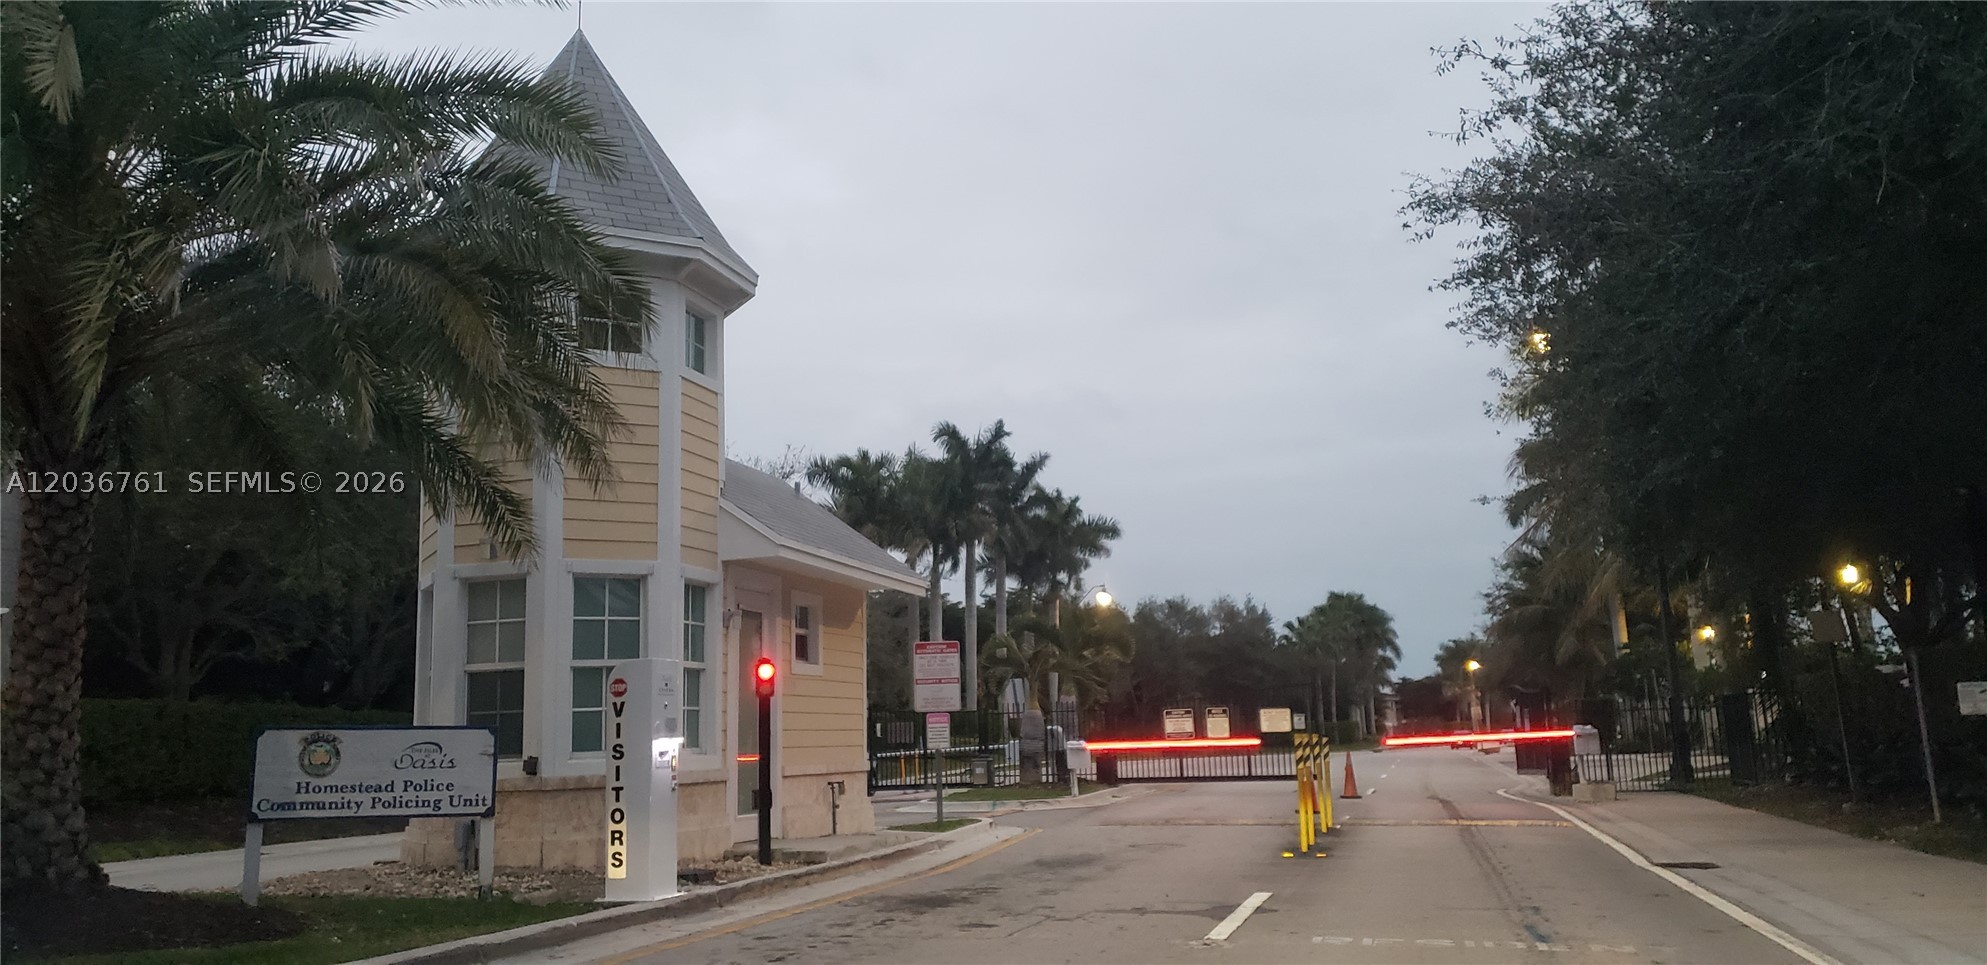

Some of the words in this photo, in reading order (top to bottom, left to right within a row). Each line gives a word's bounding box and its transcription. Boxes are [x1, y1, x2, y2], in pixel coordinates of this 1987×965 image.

[610, 683, 627, 691] STOP
[394, 753, 457, 769] Oasis
[295, 781, 395, 795] Homestead
[402, 780, 455, 793] Police
[610, 701, 625, 868] VISITORS
[257, 797, 363, 813] Community
[370, 794, 442, 812] Policing
[449, 793, 488, 808] Unit
